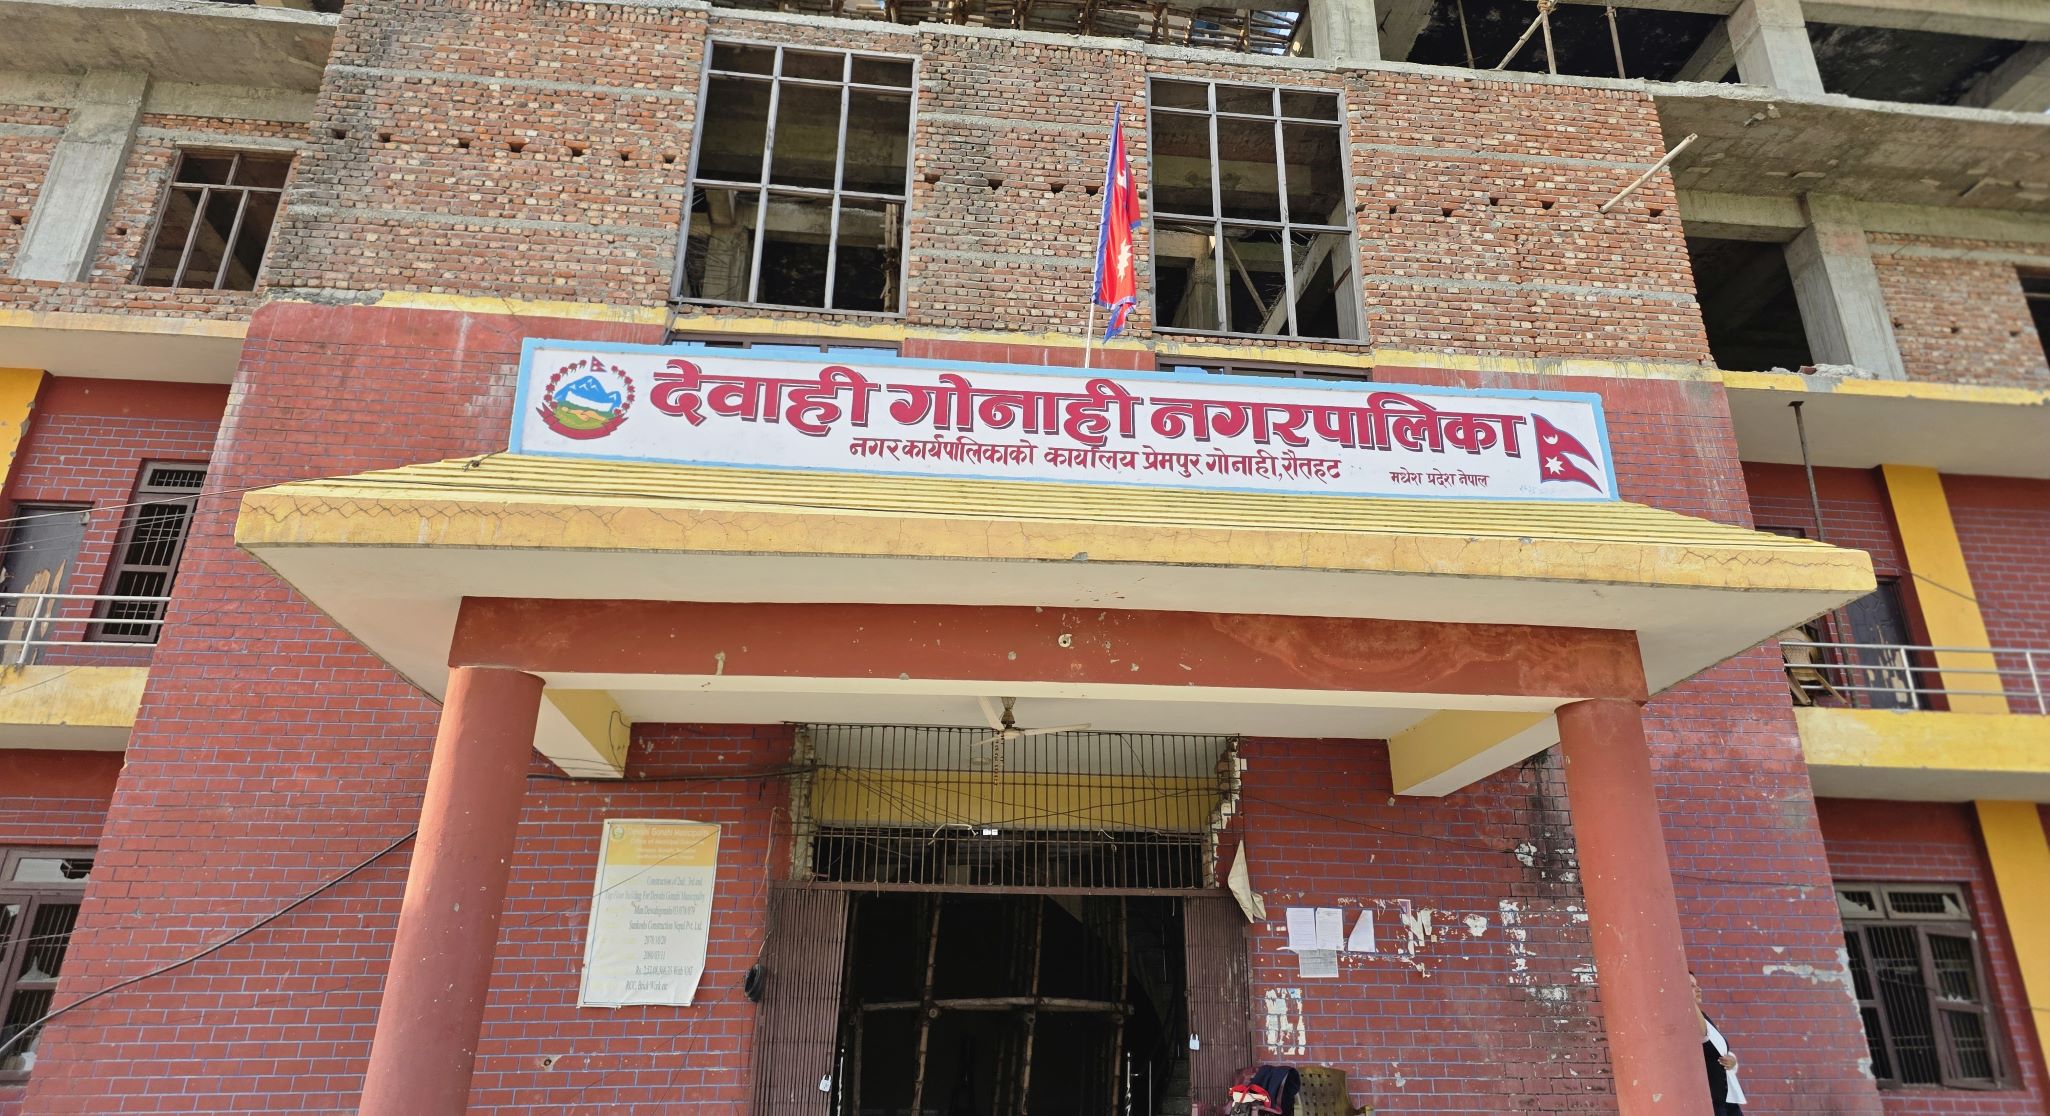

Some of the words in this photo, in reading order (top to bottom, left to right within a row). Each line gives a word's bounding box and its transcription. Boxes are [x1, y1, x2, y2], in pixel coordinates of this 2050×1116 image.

[650, 358, 882, 438] देवाही
[886, 373, 1144, 447] गोनाही
[1149, 391, 1527, 459] नगरपालिका
[902, 433, 1038, 466] कार्यपालिकाको
[1043, 446, 1140, 470] कार्यालय
[1141, 445, 1204, 479] प्रेमपुर
[1426, 467, 1457, 489] प्रदेश
[1457, 469, 1490, 488] नेपाल
